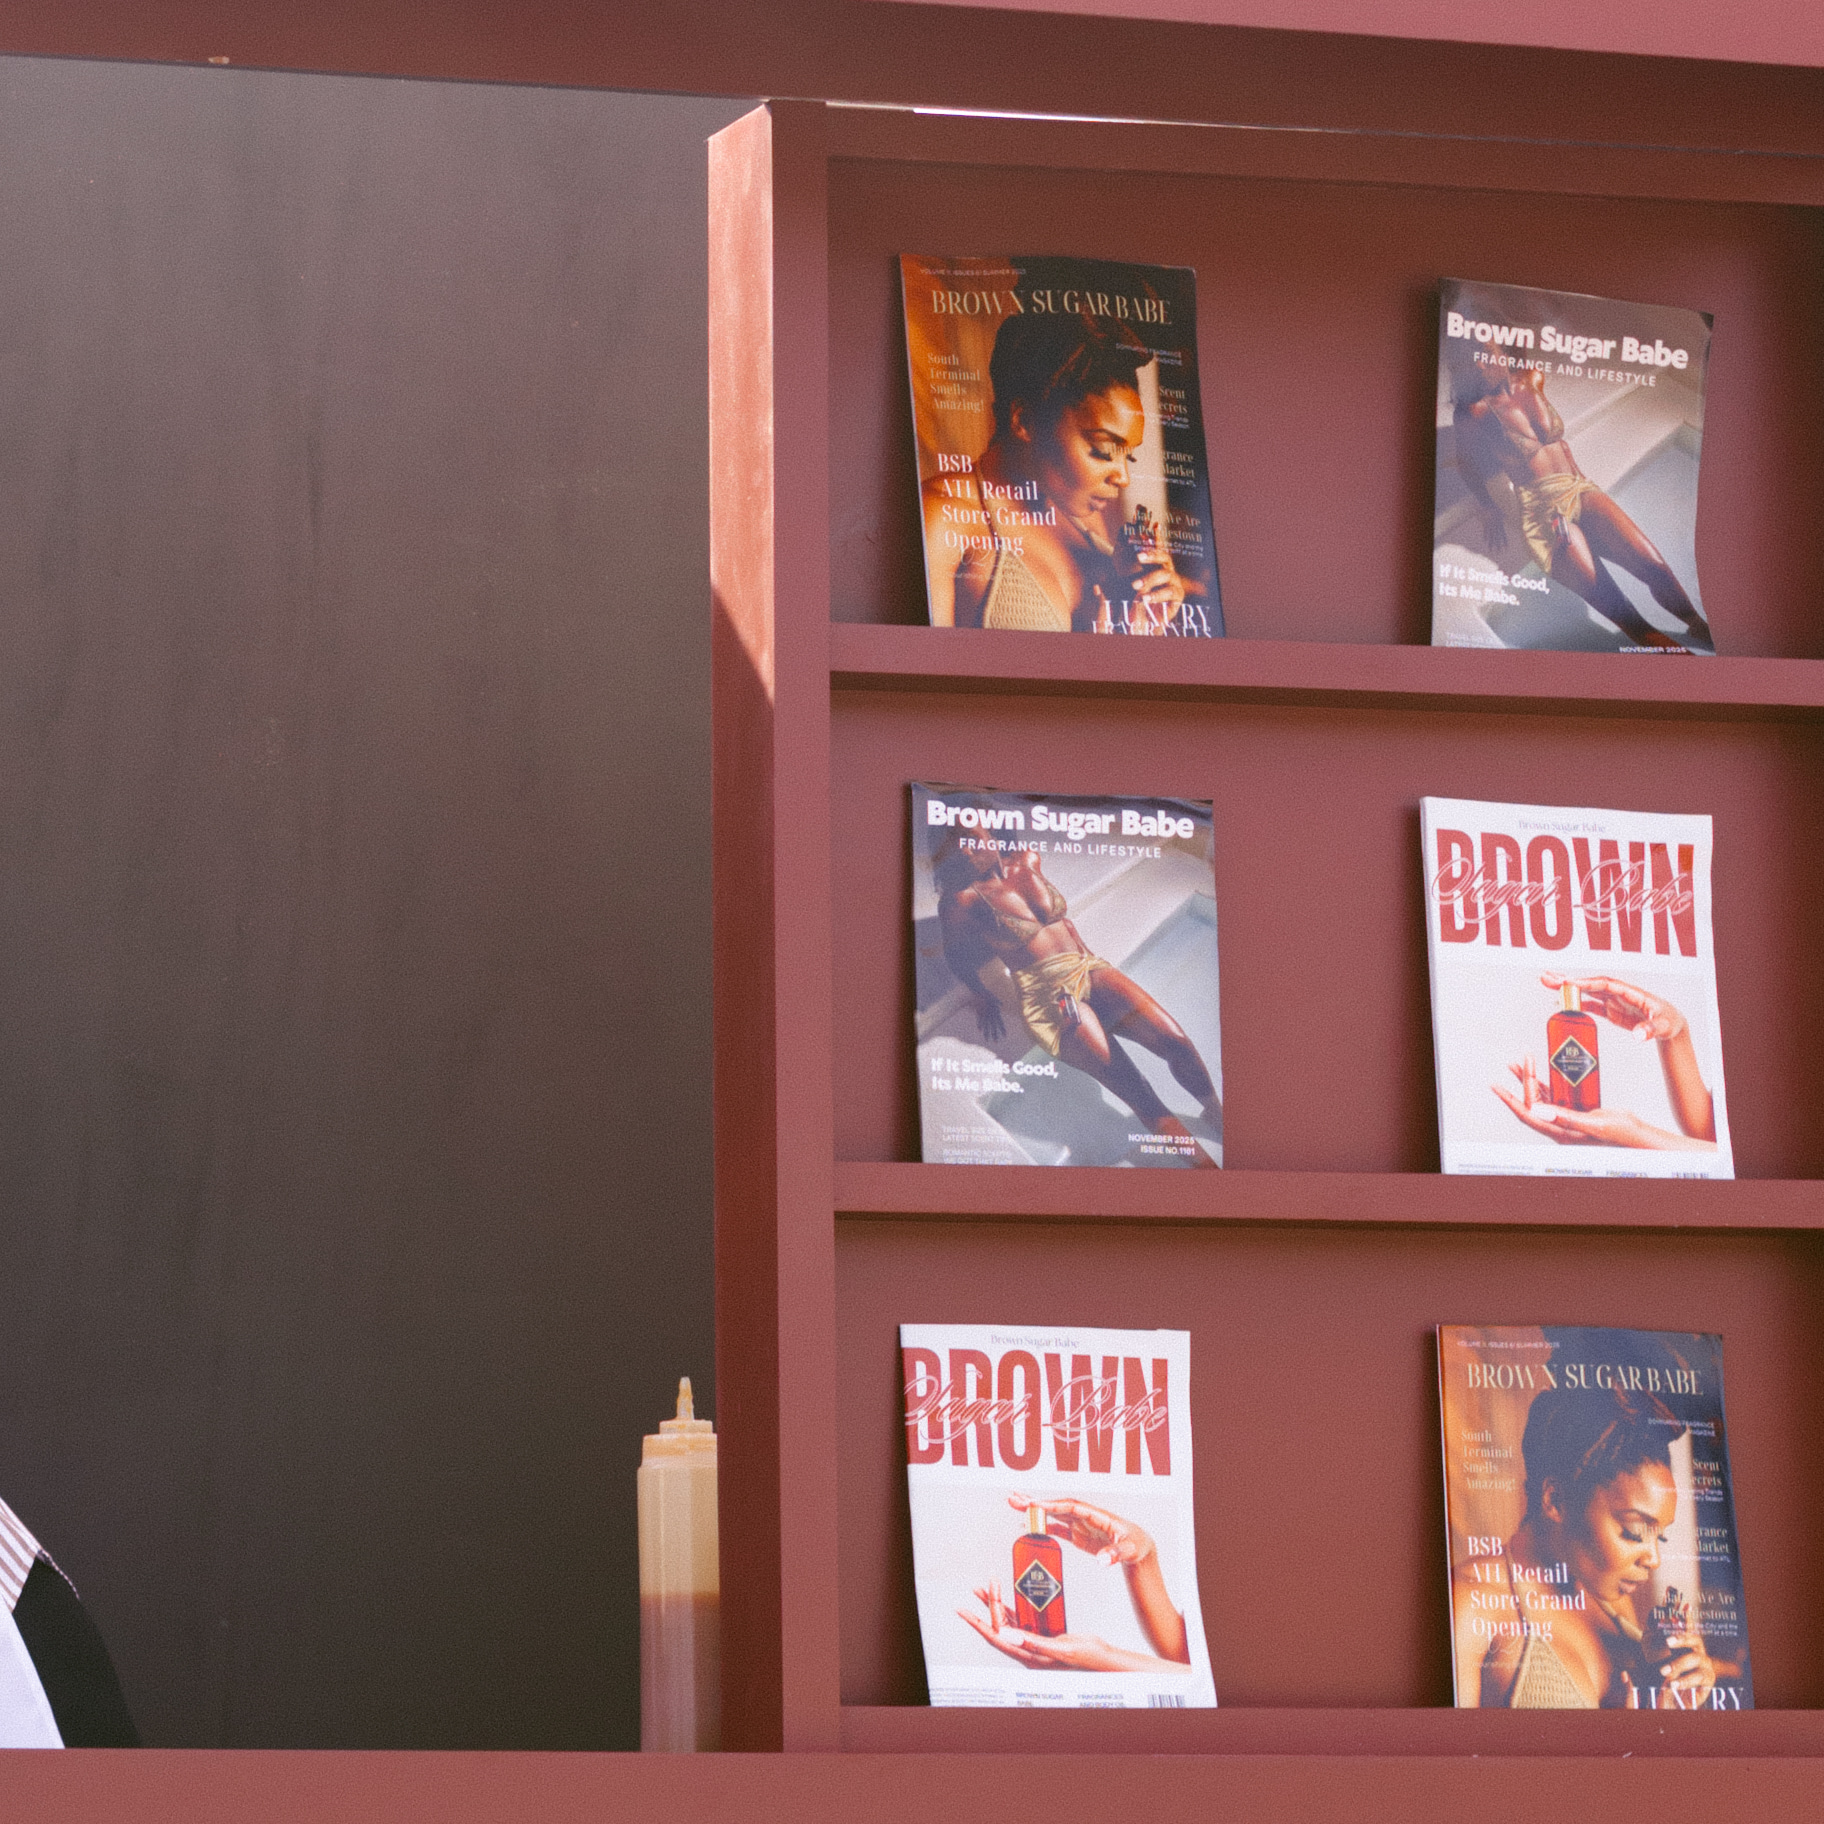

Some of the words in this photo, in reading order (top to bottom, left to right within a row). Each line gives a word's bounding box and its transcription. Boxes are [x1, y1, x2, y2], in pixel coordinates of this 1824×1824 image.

[932, 289, 1025, 315] BROWN
[1032, 289, 1112, 318] SUGAR
[1116, 296, 1173, 326] BABE
[1447, 312, 1535, 349] Brown
[1540, 326, 1616, 364] Sugar
[1621, 337, 1689, 370] Babe
[1474, 351, 1552, 373] FRAGRANCE
[1557, 364, 1583, 377] AND
[1588, 367, 1656, 387] LIFESTYLE
[938, 453, 972, 473] BSB
[940, 479, 972, 500] ATL
[982, 480, 1039, 501] Retail
[942, 505, 992, 525] Store
[996, 507, 1056, 526] Grand
[944, 531, 1024, 556] Opening
[1468, 566, 1509, 587] Smells
[1511, 574, 1550, 595] Good,
[1485, 588, 1520, 606] Babe.
[927, 800, 1024, 830] Brown
[1031, 805, 1115, 840] Sugar
[1122, 810, 1194, 839] Babe
[960, 838, 1048, 854] FRAGRANCE
[1054, 841, 1082, 854] AND
[1087, 843, 1161, 858] LIFESTYLE
[1430, 855, 1561, 924] Sugar
[1573, 858, 1694, 924] Babe
[1436, 828, 1697, 957] BROWN
[931, 1058, 944, 1071] If
[947, 1059, 960, 1072] It
[961, 1059, 1009, 1075] Smells
[1013, 1061, 1058, 1078] Good,
[931, 1076, 953, 1091] Its
[956, 1078, 976, 1092] Me
[978, 1078, 1024, 1093] Babe.
[1128, 1134, 1172, 1144] NOVEMBER
[1468, 1363, 1560, 1389] BROWN
[1566, 1364, 1644, 1390] SUGAR
[1648, 1368, 1704, 1395] BABE
[902, 1346, 1171, 1476] BROWN
[1042, 1374, 1168, 1443] Babe
[1468, 1536, 1503, 1555] BSB
[1512, 1563, 1569, 1584] Retail
[1470, 1590, 1519, 1610] Store
[1526, 1591, 1586, 1610] Grand
[1472, 1616, 1553, 1641] Opening
